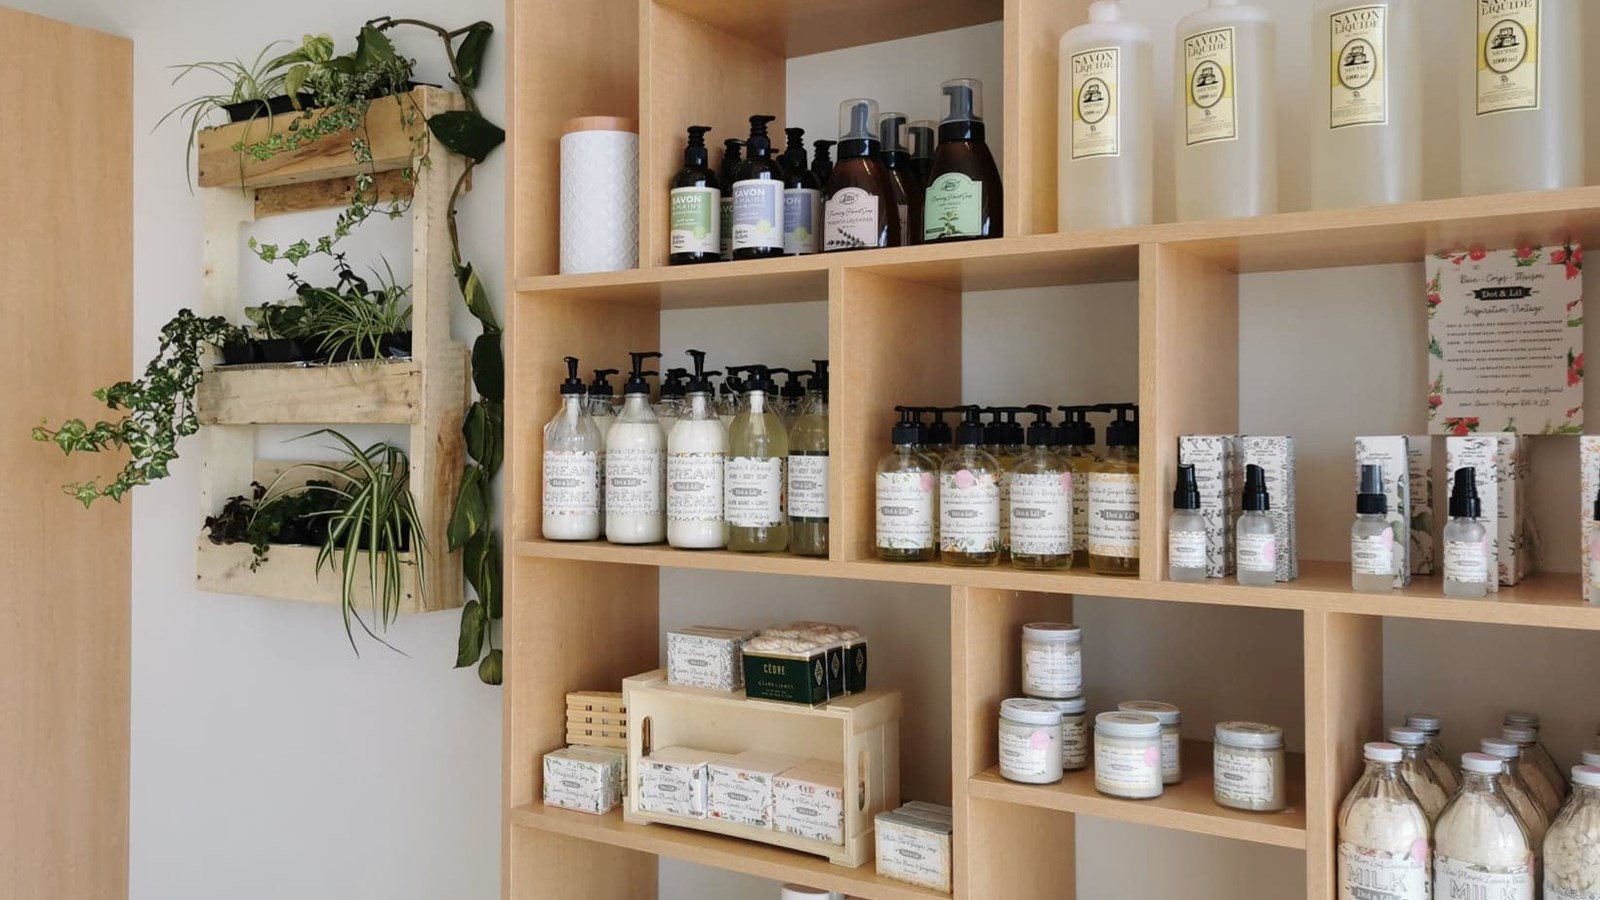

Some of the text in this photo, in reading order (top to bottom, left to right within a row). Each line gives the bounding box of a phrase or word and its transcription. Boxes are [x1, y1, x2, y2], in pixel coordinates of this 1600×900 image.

[1335, 10, 1380, 24] SAVON
[1335, 20, 1378, 35] LIQUIDE
[1188, 33, 1227, 47] SAVON
[1188, 42, 1227, 57] LIQUIDE
[1075, 52, 1113, 65] SAVON
[1075, 61, 1113, 74] LIQUIDE
[735, 187, 766, 200] SAVON
[1482, 288, 1523, 299] Dot & Lil
[1345, 863, 1407, 892] MILK
[1450, 880, 1517, 900] MILK
